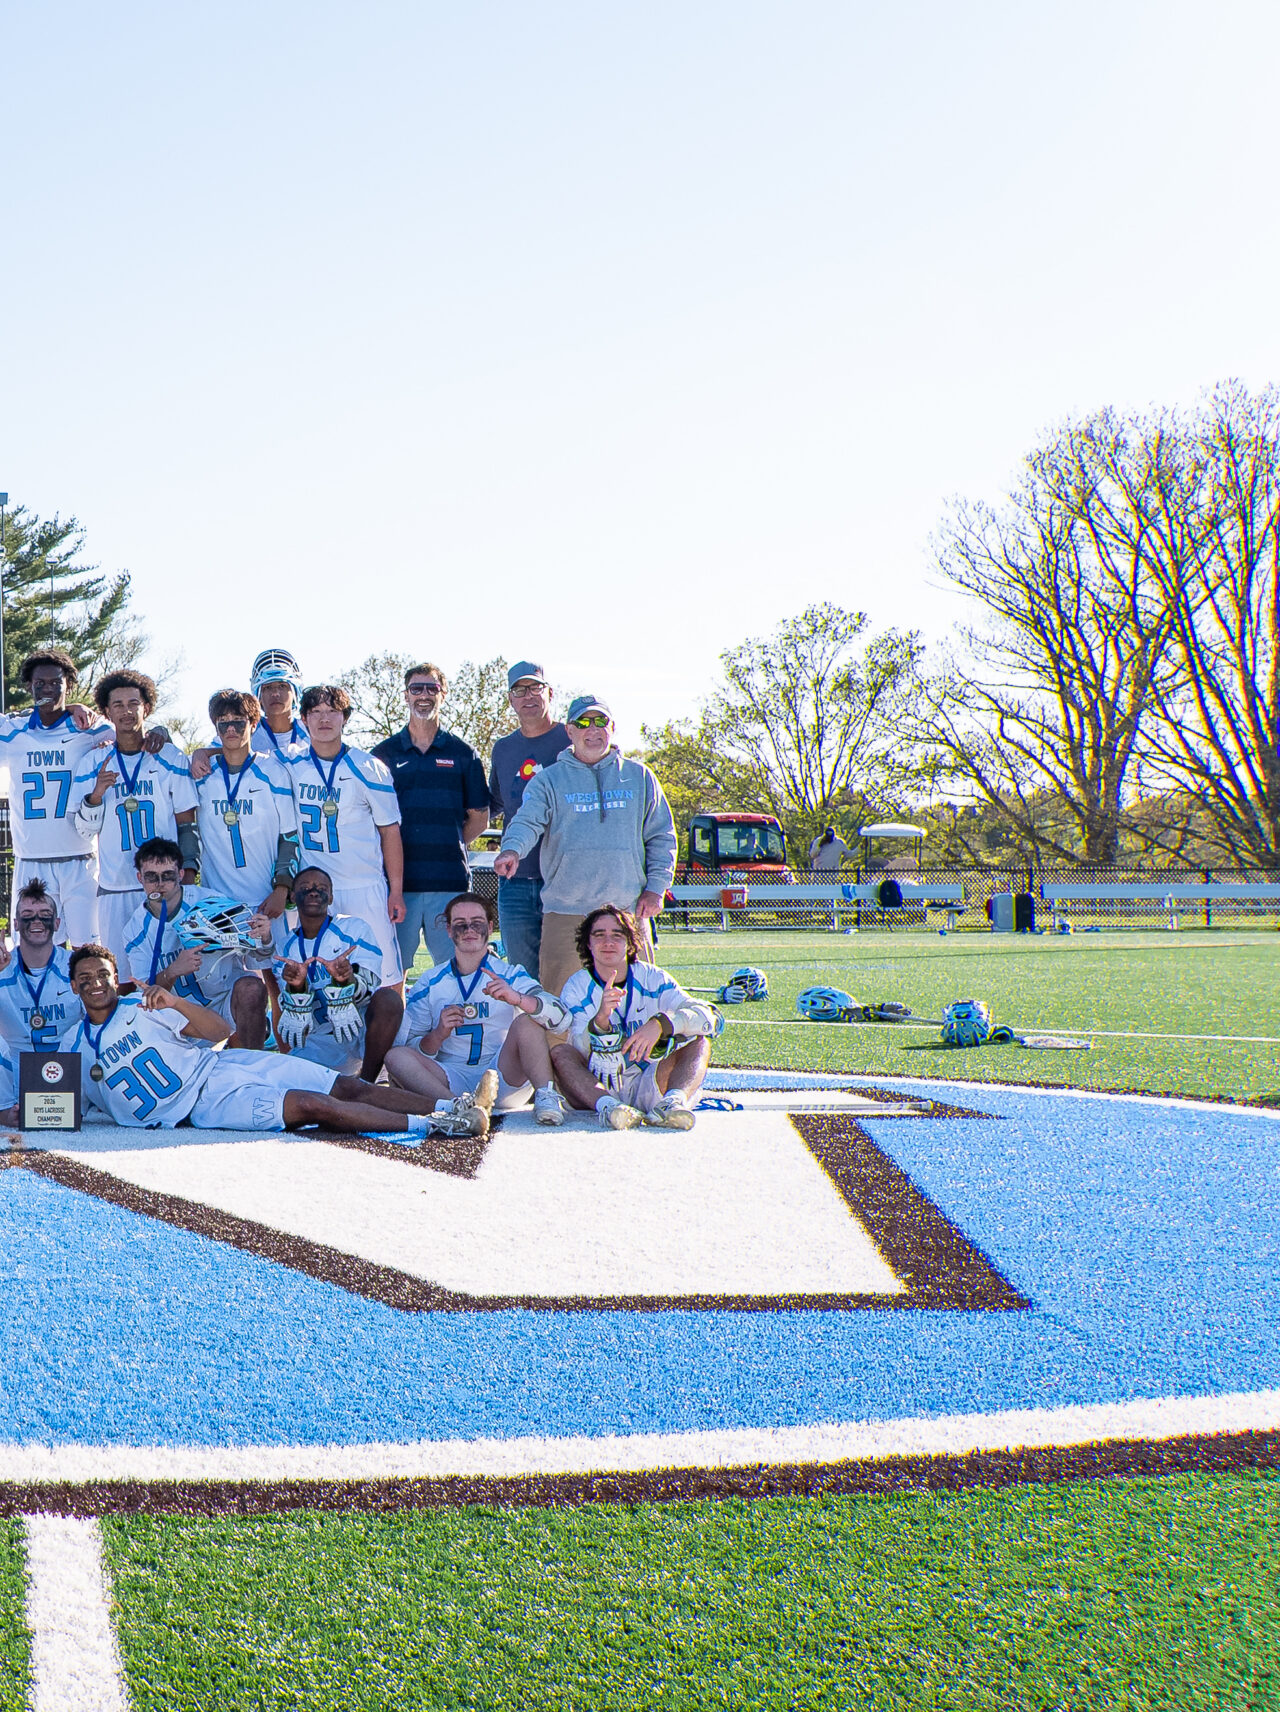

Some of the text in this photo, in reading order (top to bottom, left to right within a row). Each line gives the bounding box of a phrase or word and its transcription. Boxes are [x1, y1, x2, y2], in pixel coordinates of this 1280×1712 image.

[27, 751, 65, 767] TOWN
[22, 770, 71, 820] 27
[299, 783, 342, 803] TOWN
[564, 790, 633, 803] WESTOWN
[575, 801, 625, 812] LACRSSE
[115, 800, 156, 852] 10
[227, 819, 247, 868] 1
[299, 803, 340, 853] 21
[99, 1031, 143, 1069] TOWN
[455, 1023, 484, 1066] 7
[105, 1047, 183, 1121] 30
